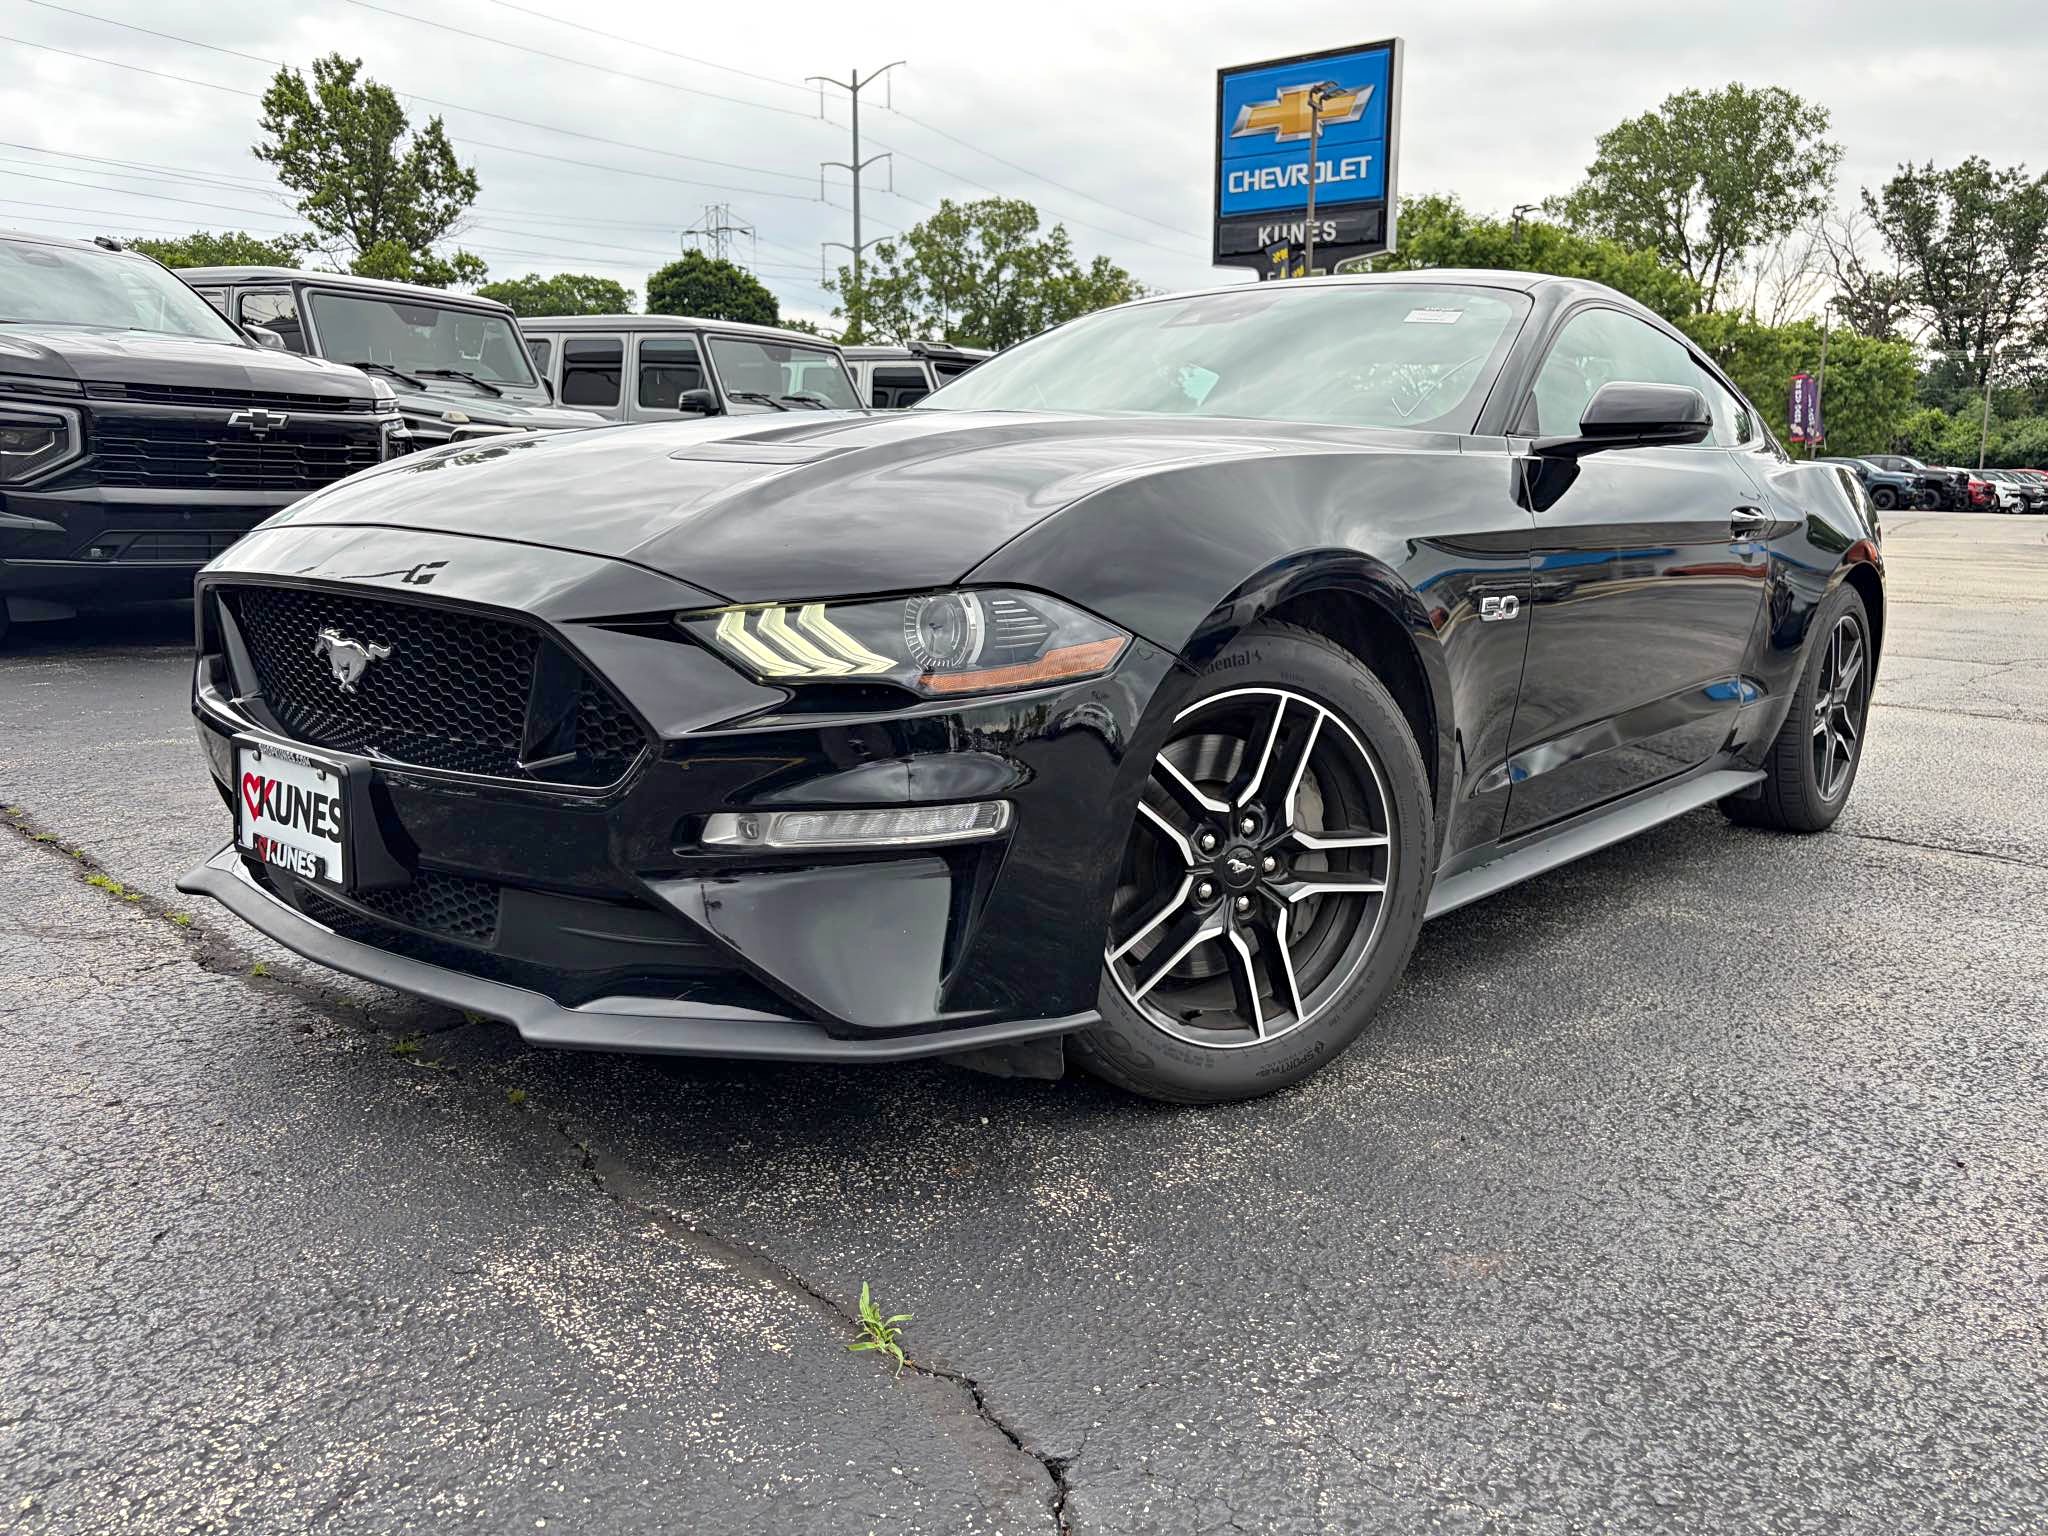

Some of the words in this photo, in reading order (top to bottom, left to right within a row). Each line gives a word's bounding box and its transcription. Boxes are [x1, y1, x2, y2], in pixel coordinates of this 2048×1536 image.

[1228, 155, 1372, 194] CHEVROLET
[1258, 220, 1337, 248] KUNES
[257, 776, 344, 843] KUNES
[266, 838, 317, 878] KUNES
